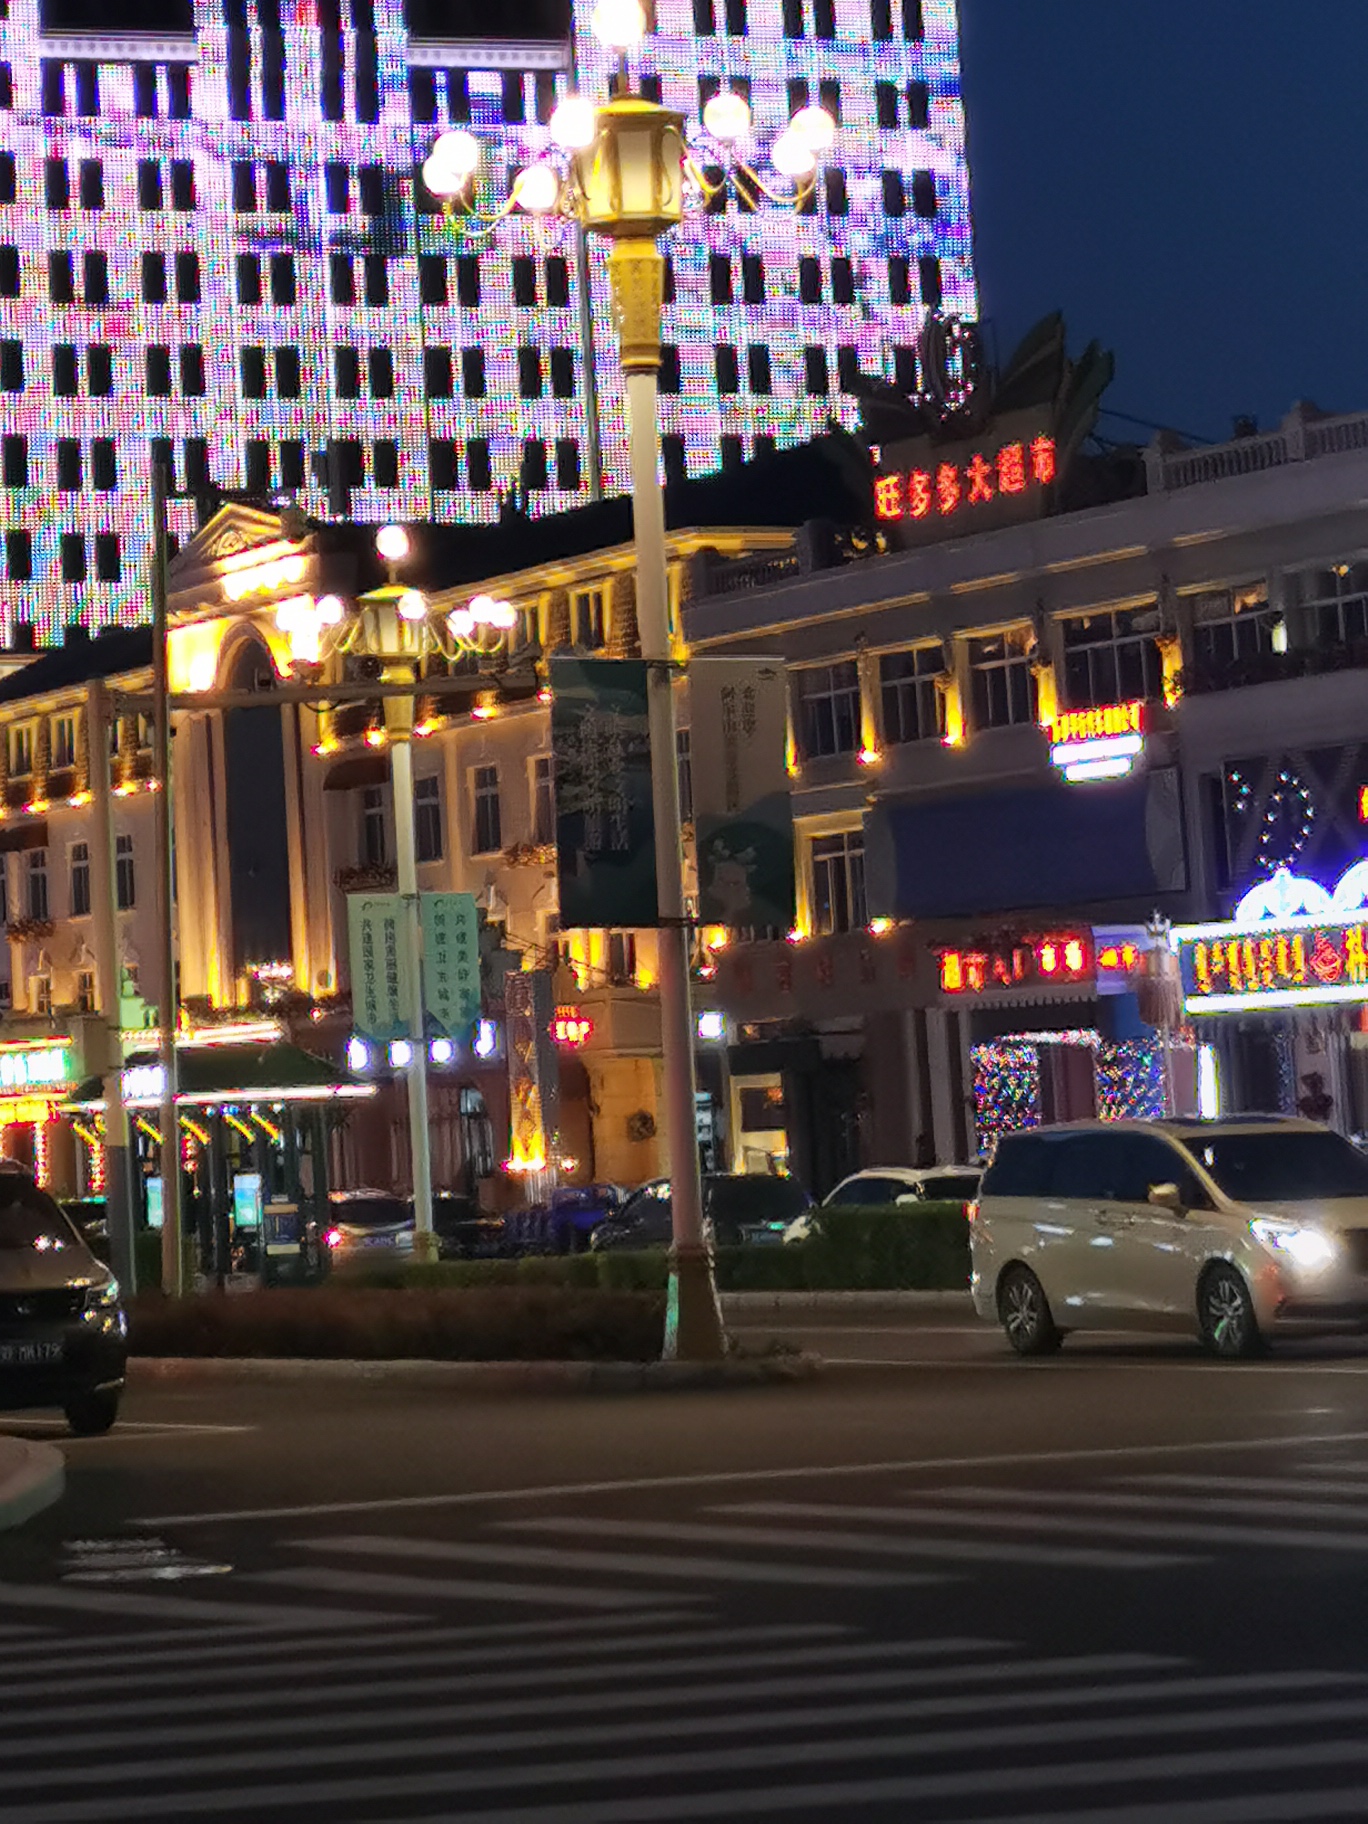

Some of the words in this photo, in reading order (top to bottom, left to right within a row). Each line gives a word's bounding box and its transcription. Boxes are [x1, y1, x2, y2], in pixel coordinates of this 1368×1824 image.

[874, 433, 1056, 521] 旺多多大超市
